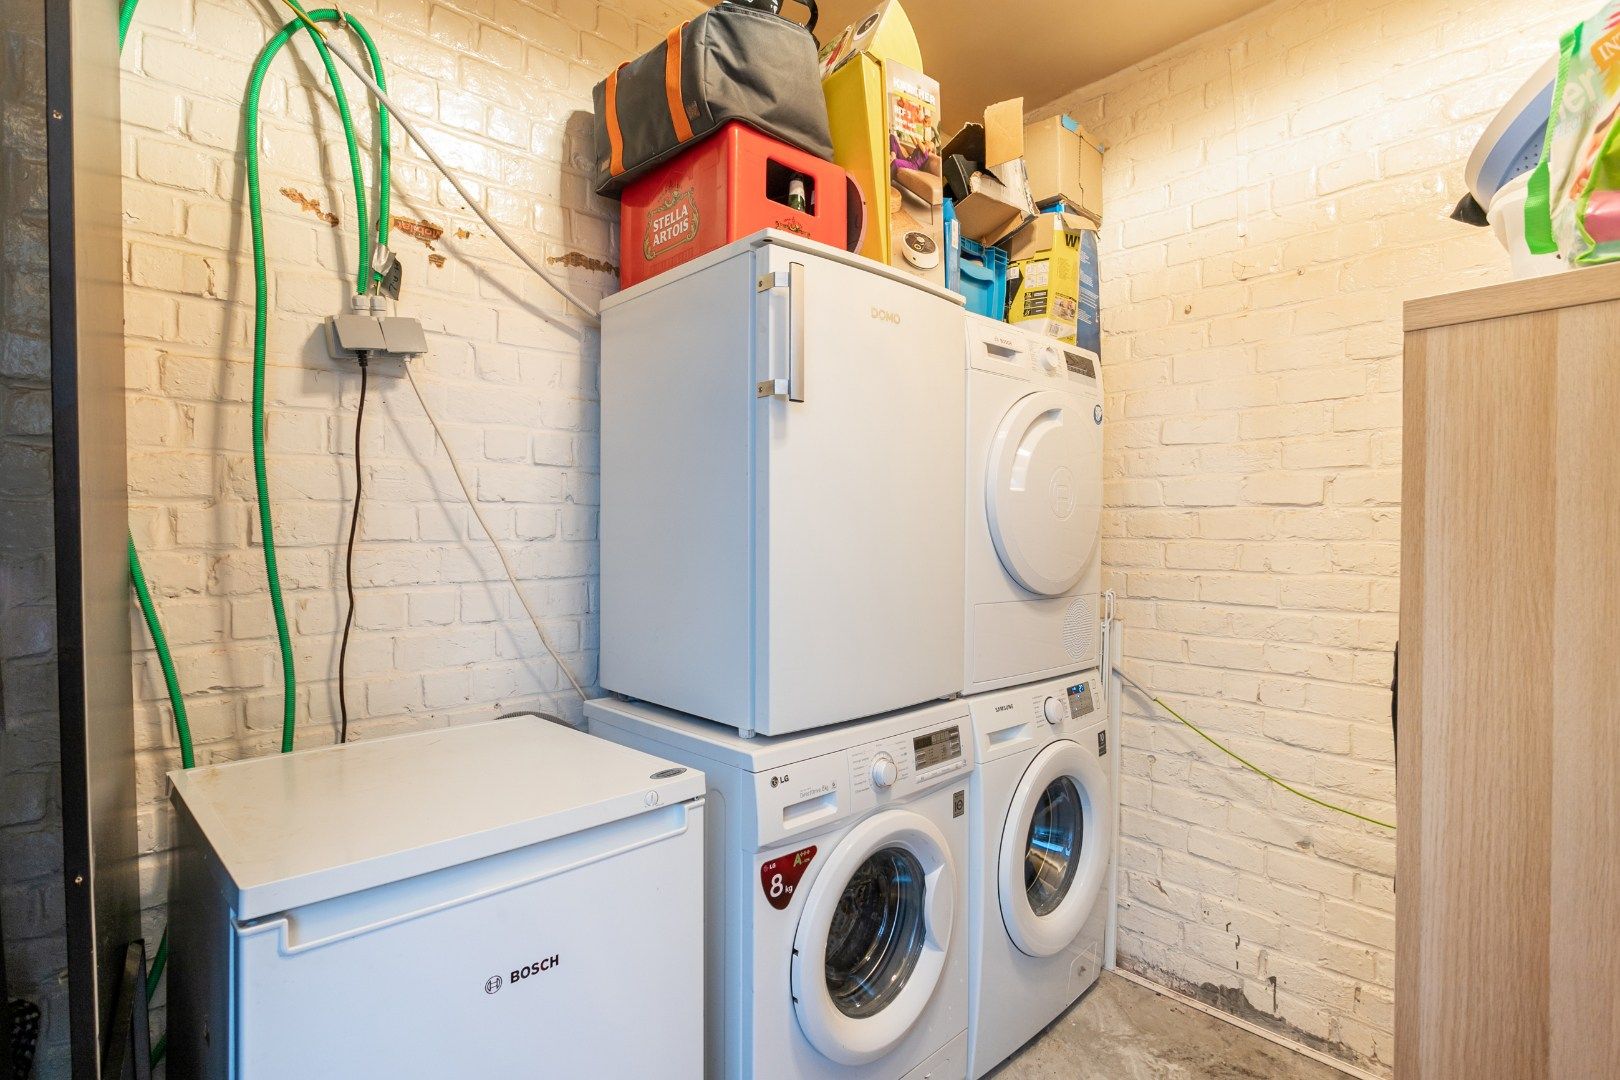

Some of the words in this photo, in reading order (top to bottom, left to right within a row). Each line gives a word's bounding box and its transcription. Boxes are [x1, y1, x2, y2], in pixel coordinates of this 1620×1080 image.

[653, 204, 689, 232] STELLA
[653, 217, 689, 247] ARTOIS
[871, 308, 901, 324] DOMO
[995, 703, 1014, 713] SAMSUNG
[780, 774, 789, 784] LG
[770, 873, 783, 898] 8
[784, 885, 793, 894] kg
[509, 953, 559, 984] BOSCH
